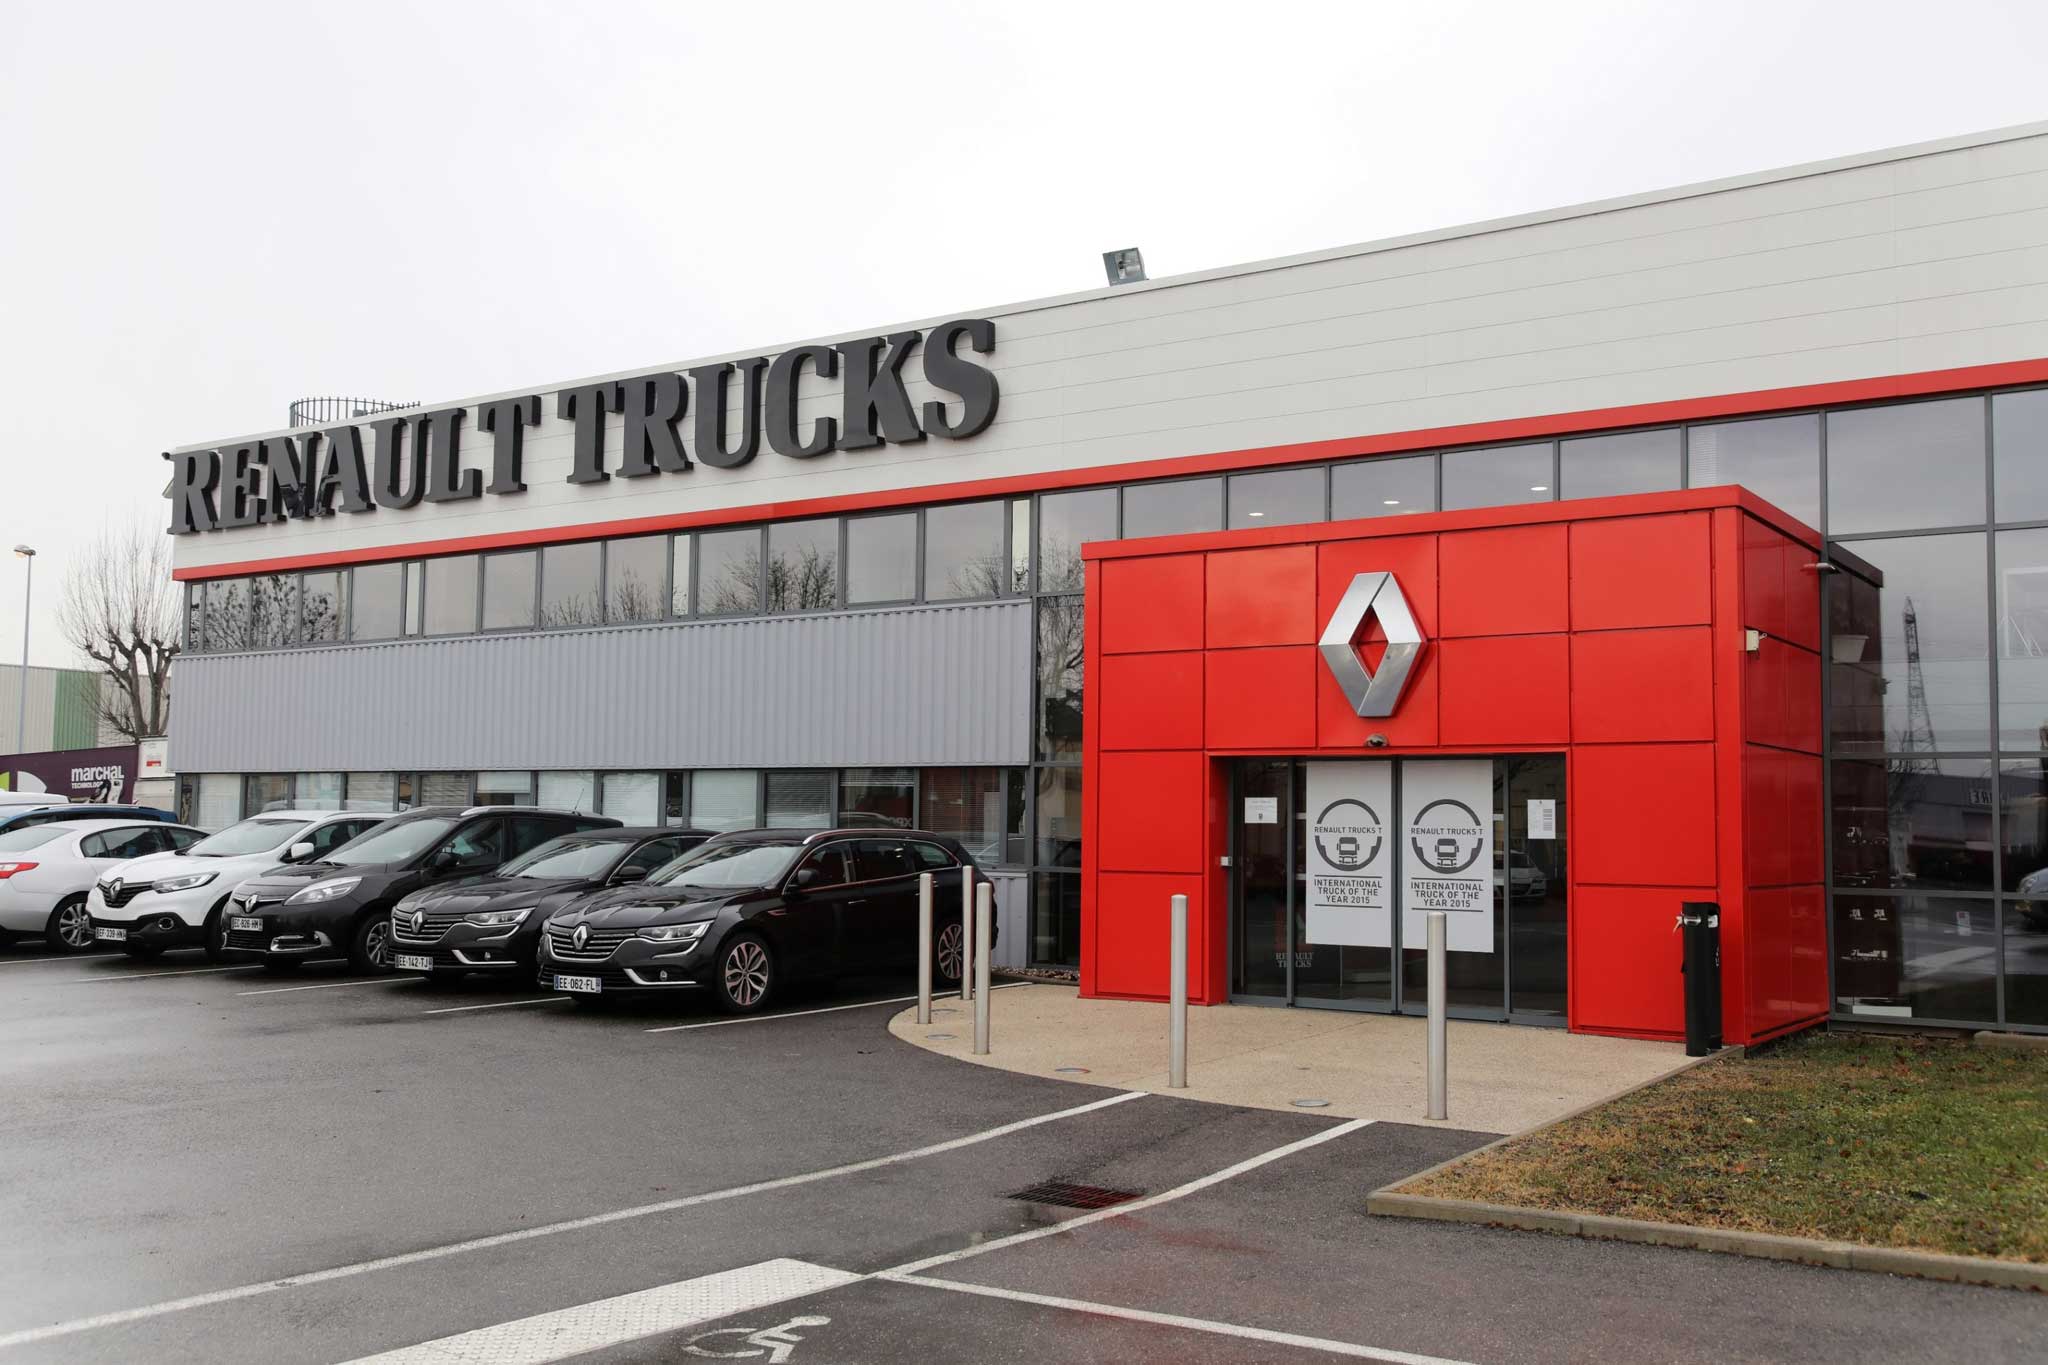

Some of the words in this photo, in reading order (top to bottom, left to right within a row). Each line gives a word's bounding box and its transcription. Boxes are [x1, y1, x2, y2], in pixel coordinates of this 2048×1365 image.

[167, 395, 541, 535] RENAULT
[557, 318, 1000, 484] TRUCKS
[1314, 826, 1346, 834] RENAULT
[1348, 826, 1376, 834] TRUCKS
[1410, 827, 1445, 835] RENAULT
[1313, 879, 1383, 889] INTERNATIONAL
[1410, 881, 1484, 891] INTERNATIONAL
[1318, 886, 1346, 895] TRUCK
[1348, 887, 1359, 896] OF
[1361, 888, 1379, 897] THE
[1415, 890, 1445, 898] TRUCK
[1447, 891, 1459, 899] OF
[1462, 891, 1480, 900] THE
[1326, 895, 1349, 903] YEAR
[1351, 896, 1370, 904] 2015
[1423, 898, 1448, 907] YEAR
[1450, 899, 1471, 908] 2015
[559, 977, 596, 991] EE-062-FL
